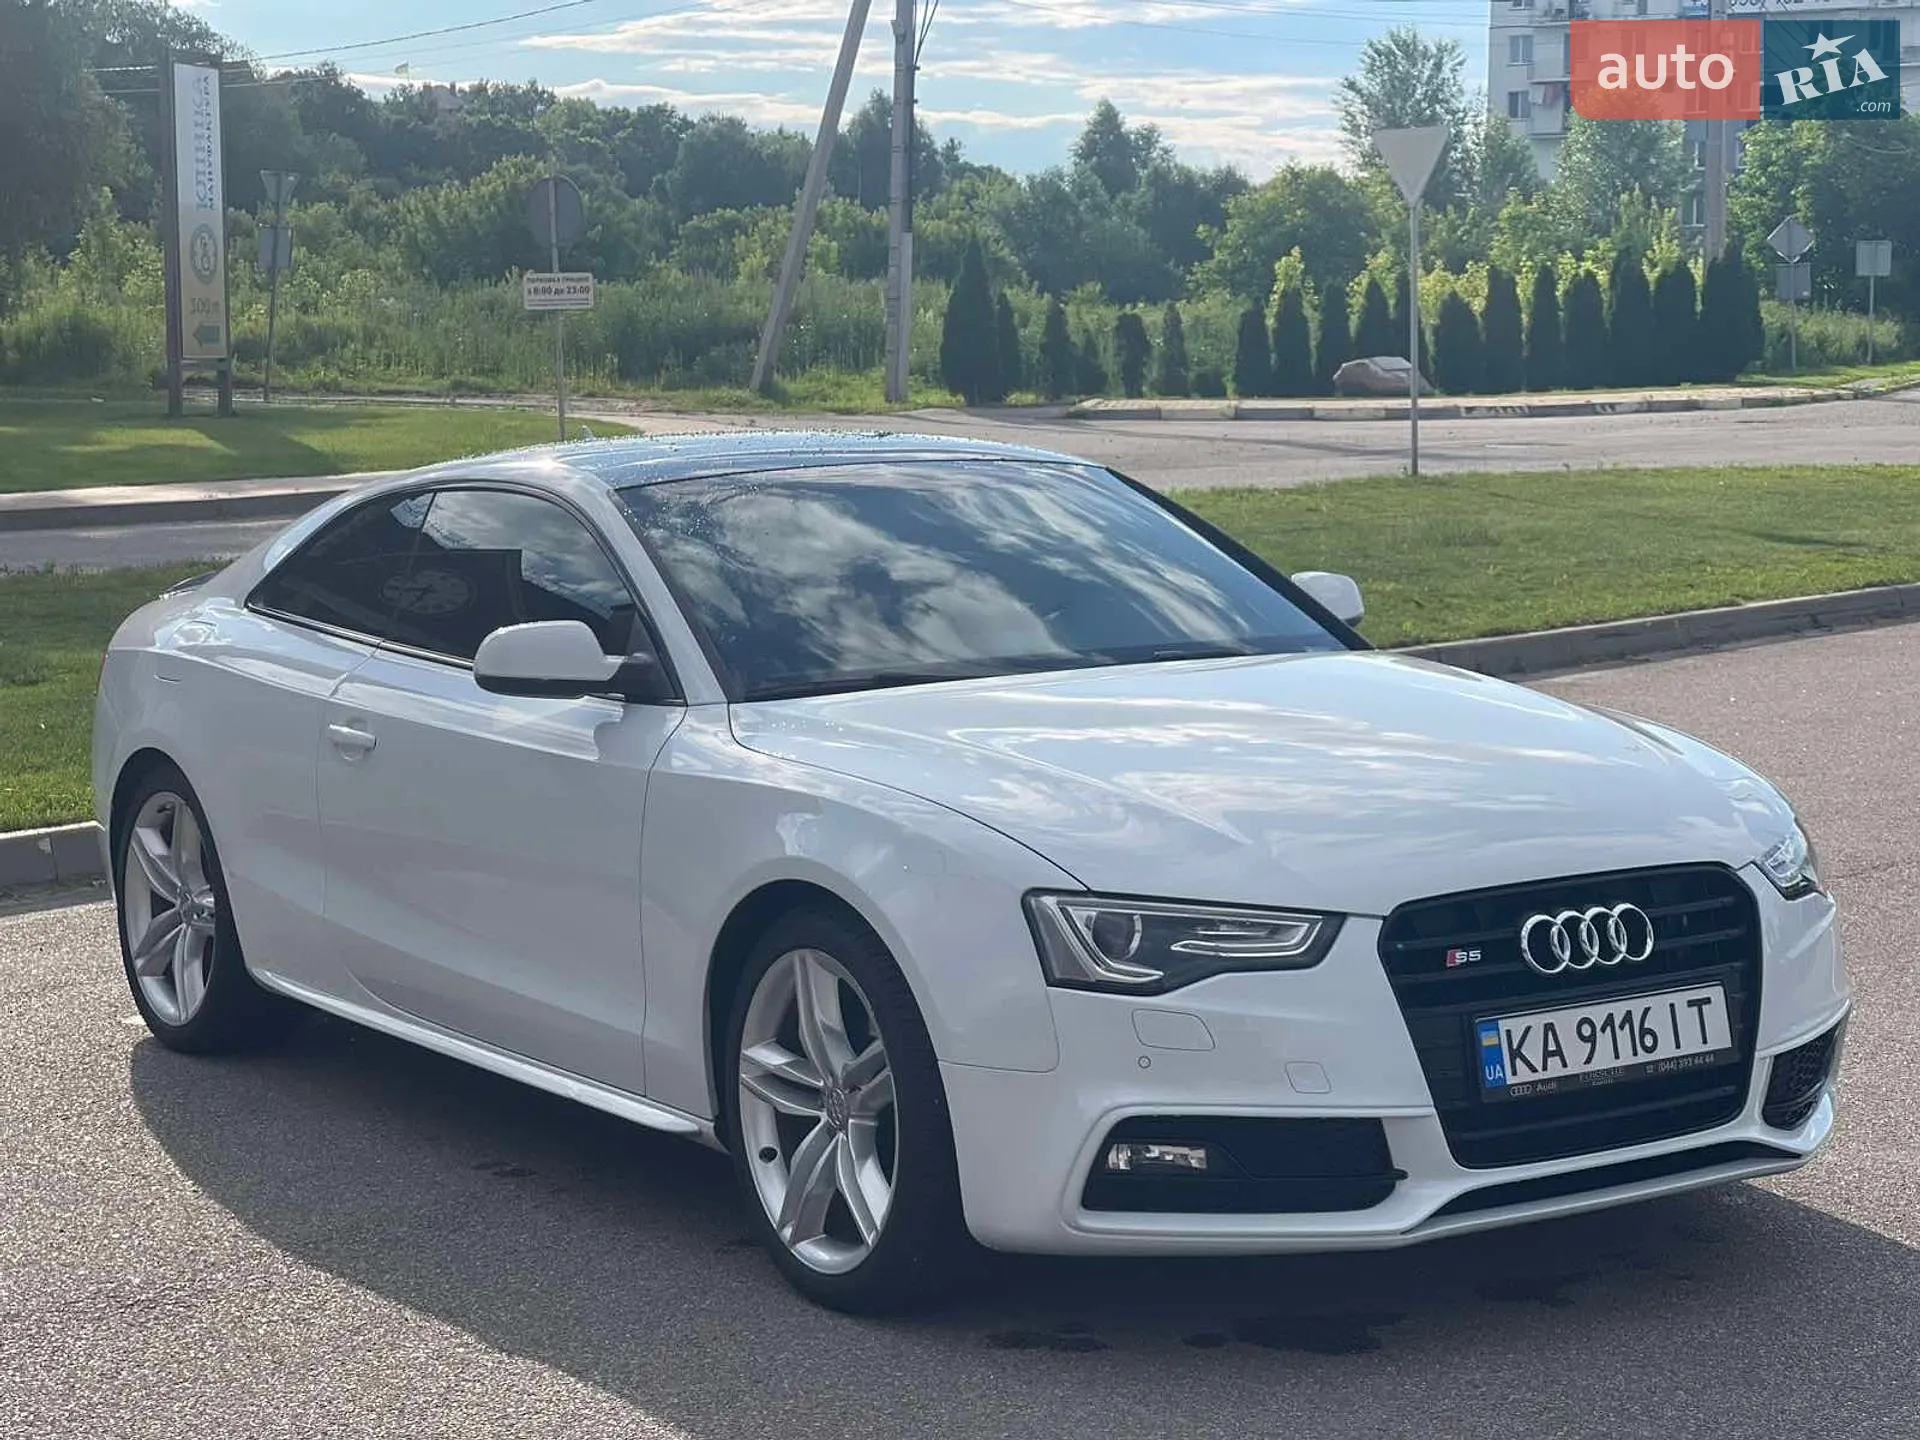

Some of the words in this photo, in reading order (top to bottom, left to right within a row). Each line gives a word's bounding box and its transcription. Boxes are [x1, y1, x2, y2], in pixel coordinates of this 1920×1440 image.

[1505, 1022, 1568, 1077] KA
[1576, 1007, 1659, 1065] 9116
[1669, 997, 1712, 1050] IT
[1485, 1065, 1504, 1081] UA
